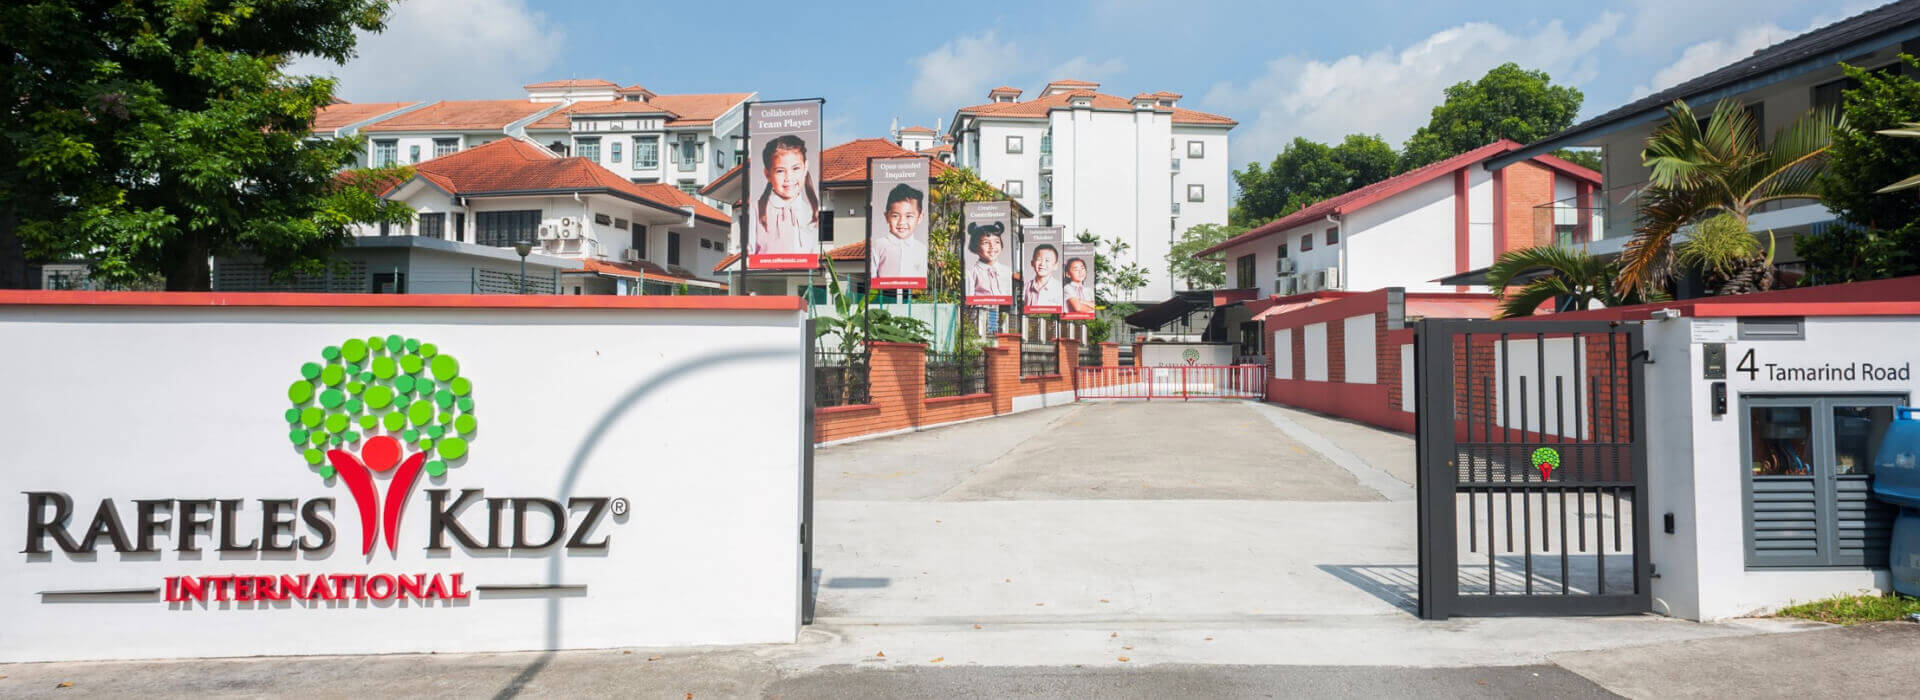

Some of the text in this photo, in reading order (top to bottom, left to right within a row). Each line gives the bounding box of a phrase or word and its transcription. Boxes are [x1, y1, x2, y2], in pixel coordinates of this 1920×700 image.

[761, 107, 809, 118] Collaborative
[758, 119, 813, 129] Team Player
[885, 171, 917, 180] Inquirer
[1736, 348, 1911, 382] 4 Tamarind Road
[18, 490, 337, 554] RAFFLES
[162, 571, 472, 602] INTERNATIONAL
